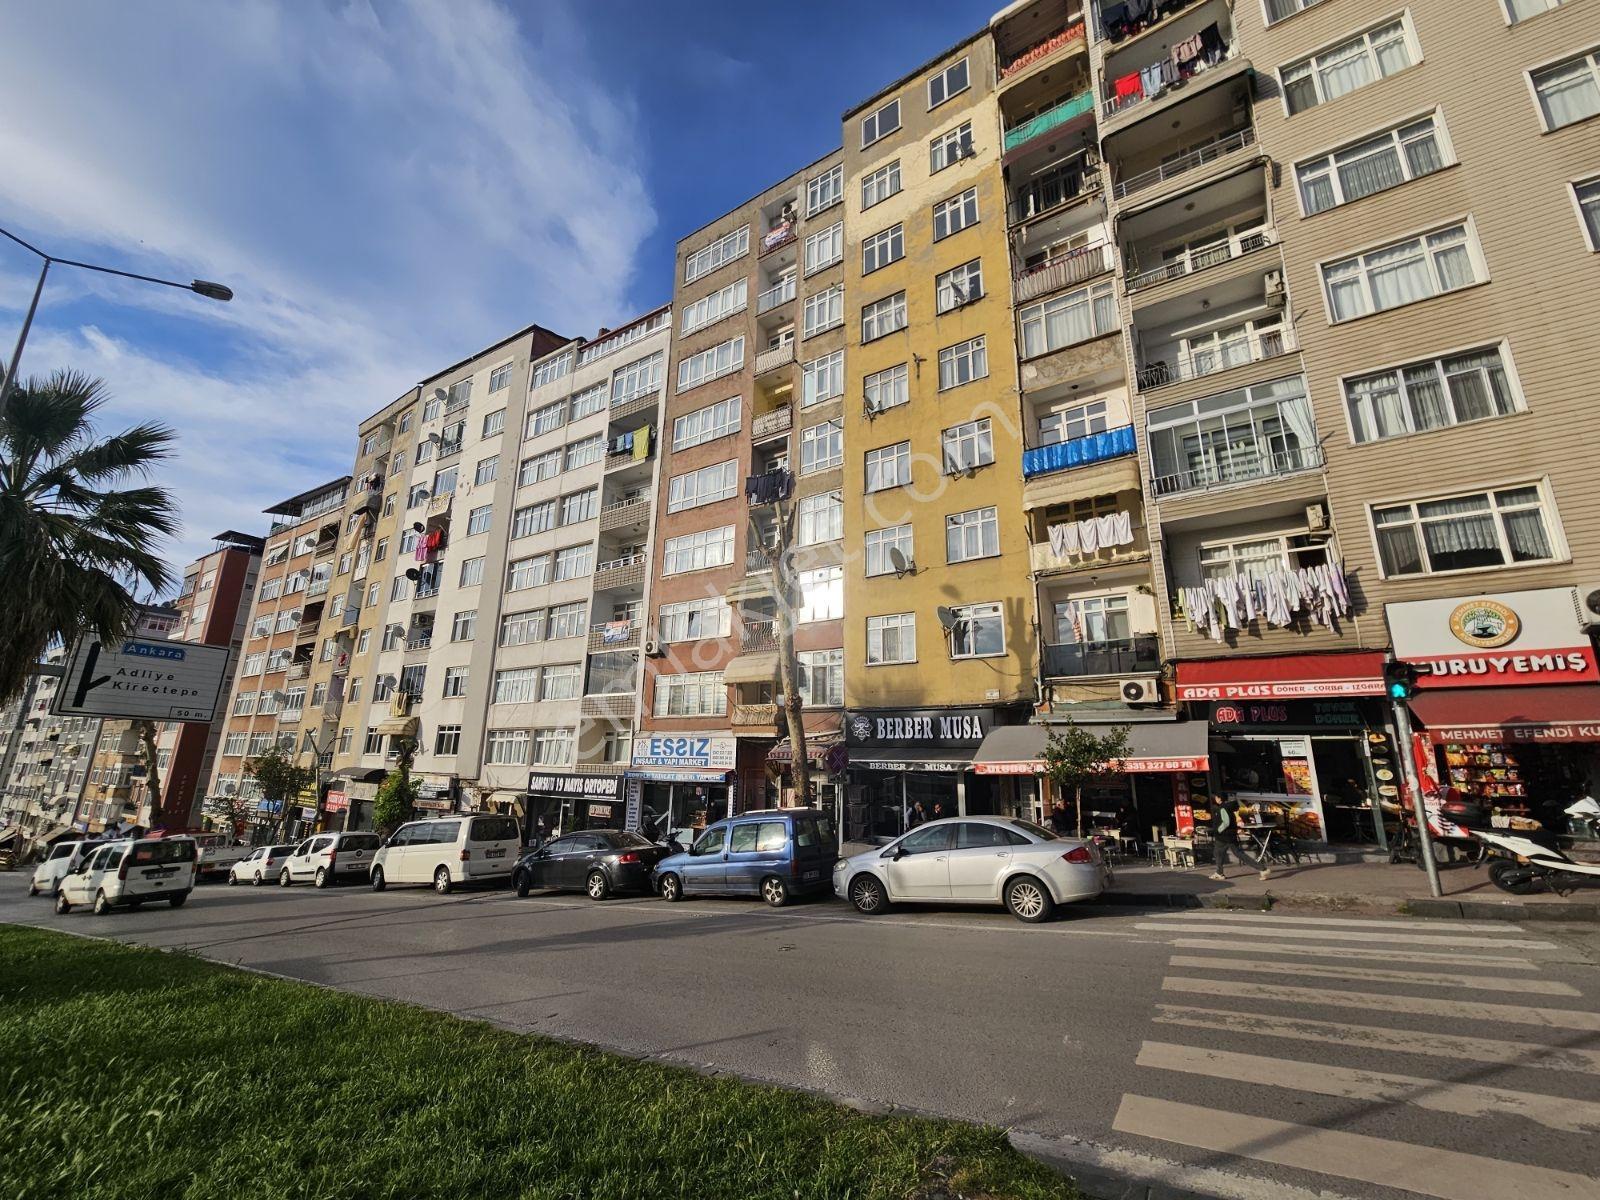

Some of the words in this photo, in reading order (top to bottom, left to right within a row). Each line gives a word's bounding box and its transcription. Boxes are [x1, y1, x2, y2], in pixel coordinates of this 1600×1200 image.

[127, 644, 183, 659] Ankara
[1406, 653, 1586, 675] URUYEMİŞ
[116, 667, 175, 681] Adliye
[112, 681, 199, 697] Kireçtepe
[1183, 686, 1220, 698] ADA
[1226, 685, 1270, 697] PLUS
[1216, 706, 1244, 723] ADA
[1251, 706, 1287, 721] PLUS
[876, 717, 933, 739] BERBER
[940, 716, 983, 739] MUSA
[1441, 730, 1505, 740] MEHMET
[1514, 726, 1573, 739] EFENDİ
[657, 758, 664, 766] &
[664, 758, 678, 766] YAPI
[679, 758, 705, 767] MARKET
[869, 762, 906, 770] BERBER
[924, 763, 952, 771] MUSA
[555, 777, 564, 792] 19
[584, 775, 618, 794] ORTOPEDİ
